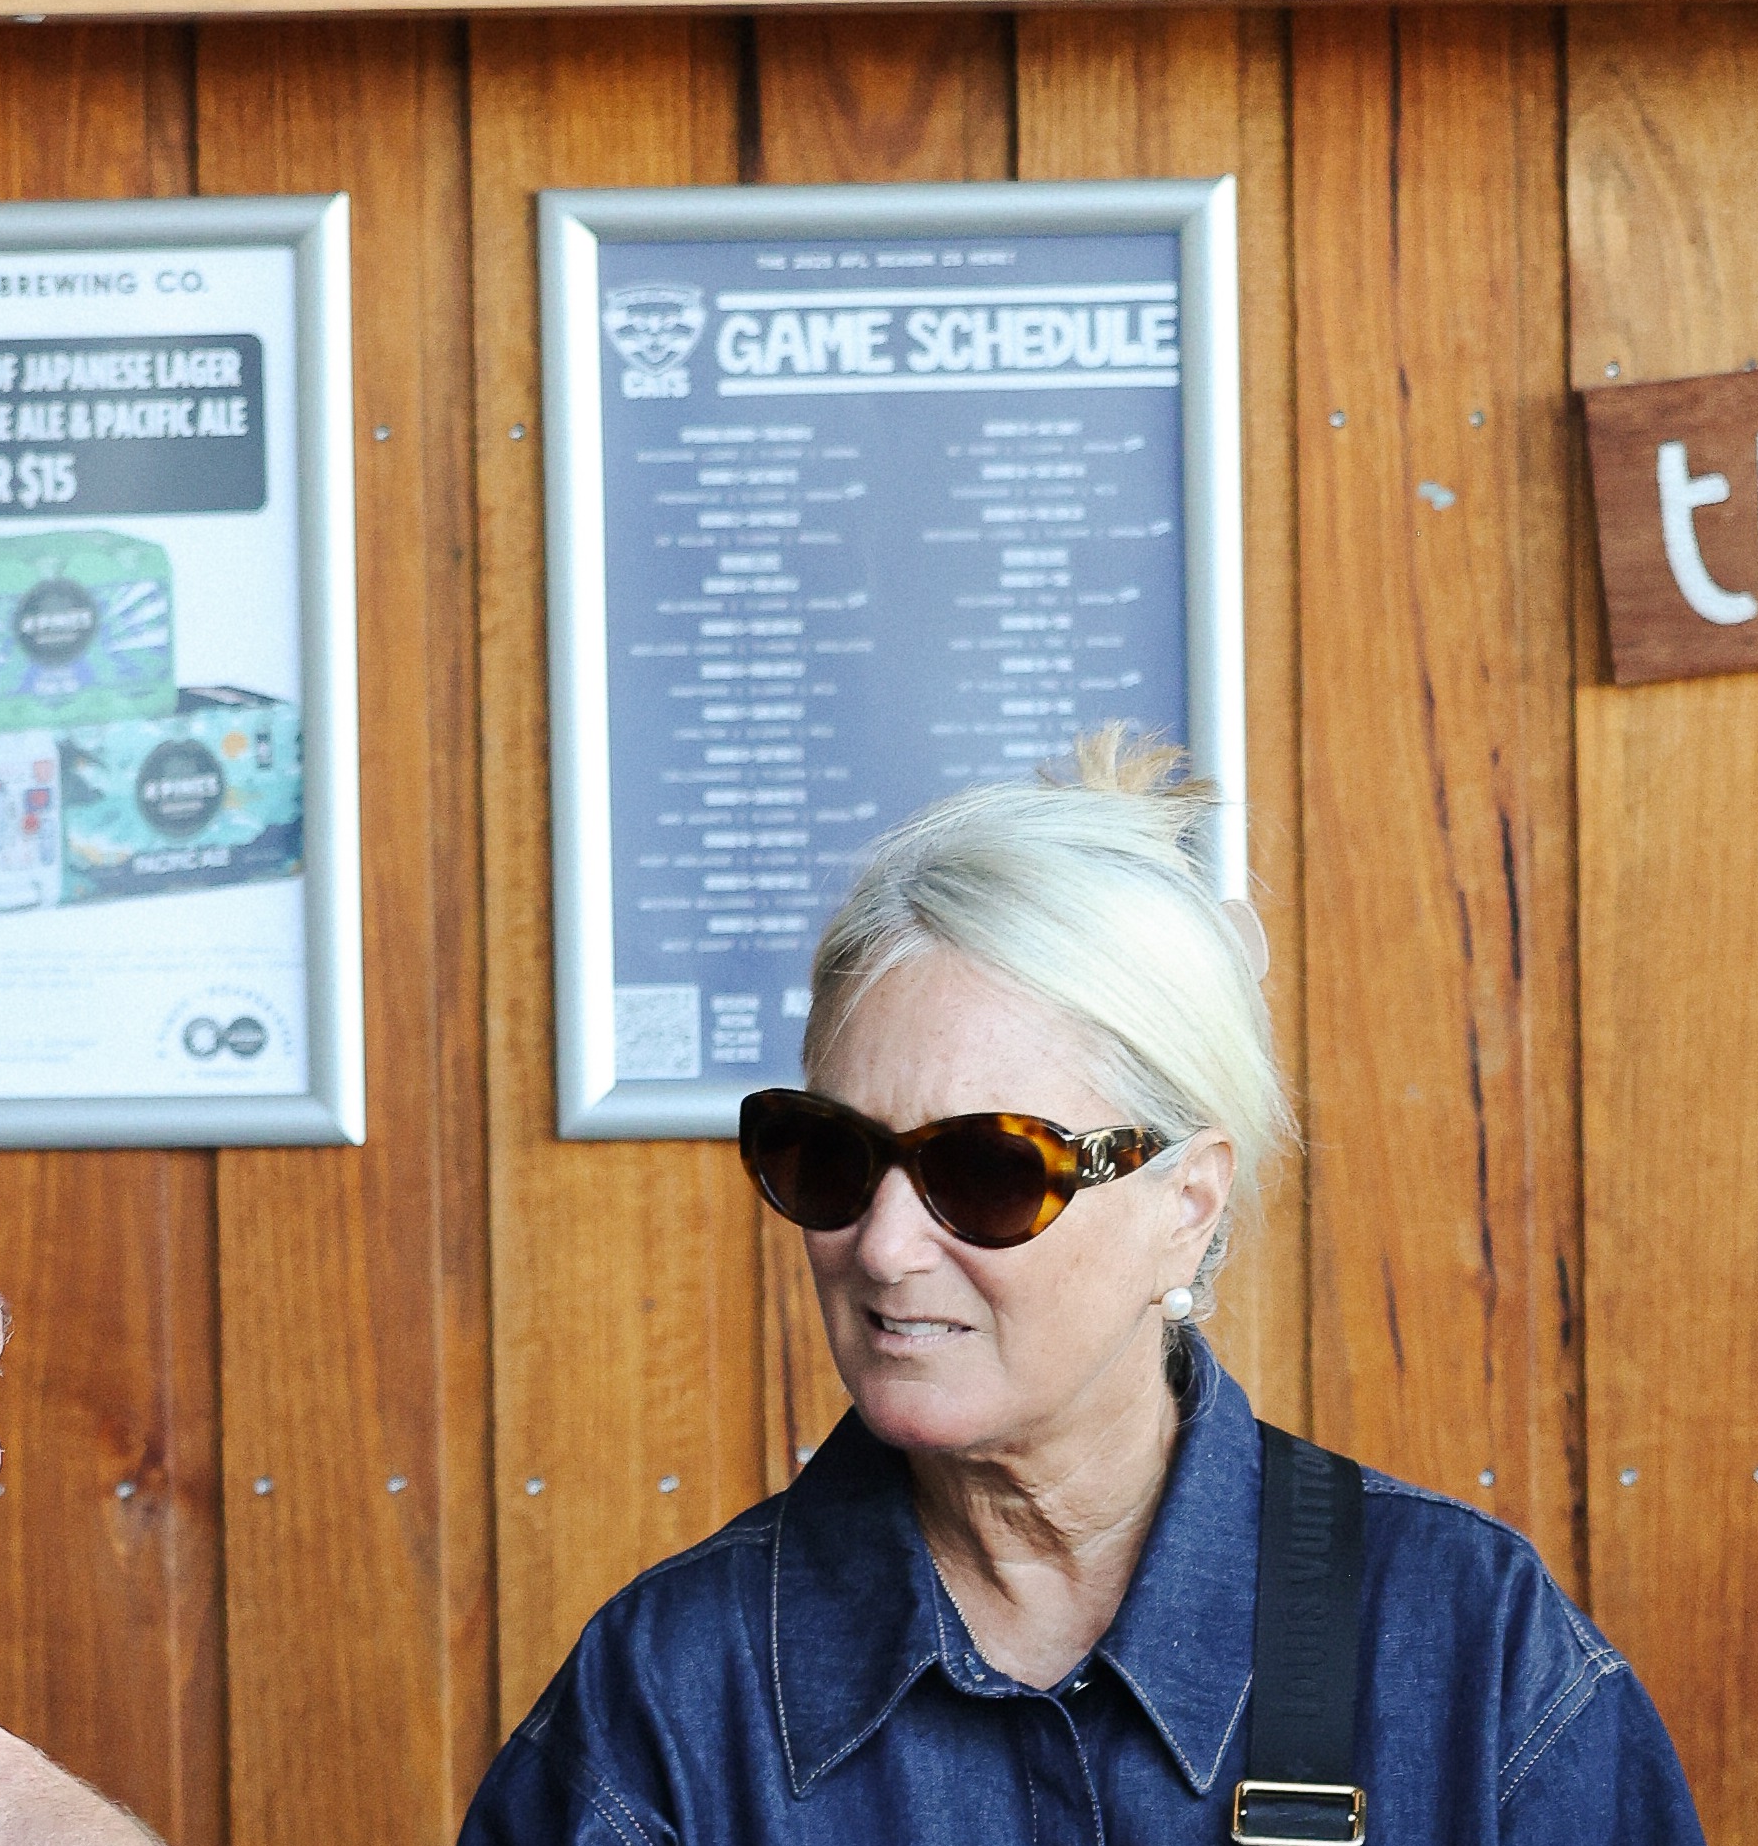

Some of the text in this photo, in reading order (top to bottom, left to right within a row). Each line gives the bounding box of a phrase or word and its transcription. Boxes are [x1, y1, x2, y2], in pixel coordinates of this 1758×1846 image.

[155, 268, 209, 295] CO.
[717, 304, 1180, 376] GAME SCHEDULE
[21, 349, 153, 393] JAPANESE
[155, 347, 241, 389] LAGER
[16, 401, 64, 441] ALE
[95, 398, 194, 439] PACIFIC
[196, 397, 248, 438] ALE
[17, 453, 78, 511] $15
